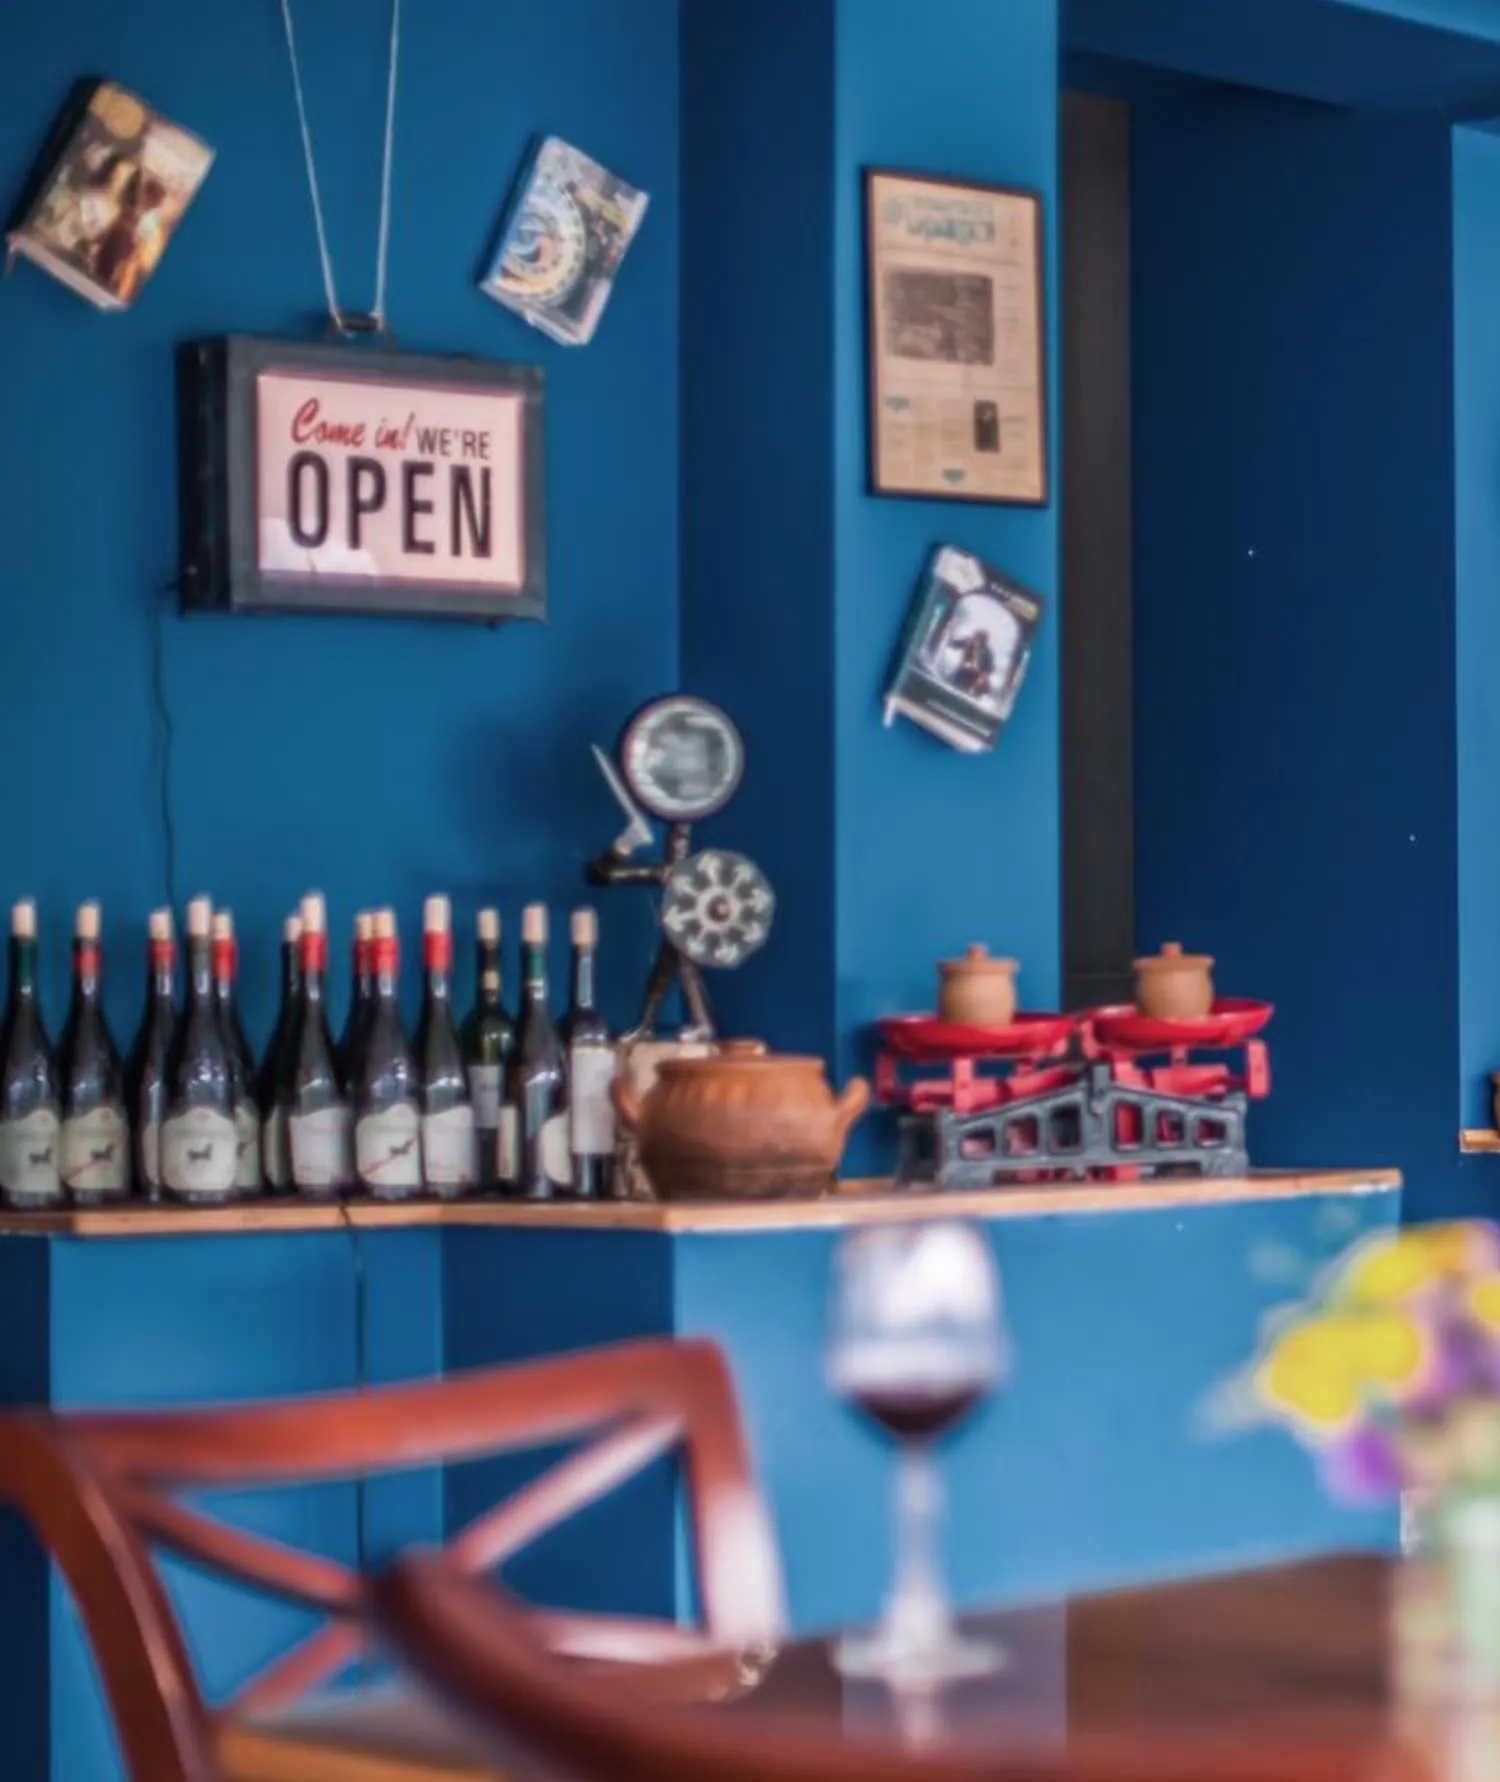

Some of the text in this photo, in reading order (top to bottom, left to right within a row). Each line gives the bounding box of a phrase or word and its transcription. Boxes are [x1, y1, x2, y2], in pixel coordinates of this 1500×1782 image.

[291, 397, 491, 460] Come in! WE'RE
[287, 449, 492, 559] OPEN
